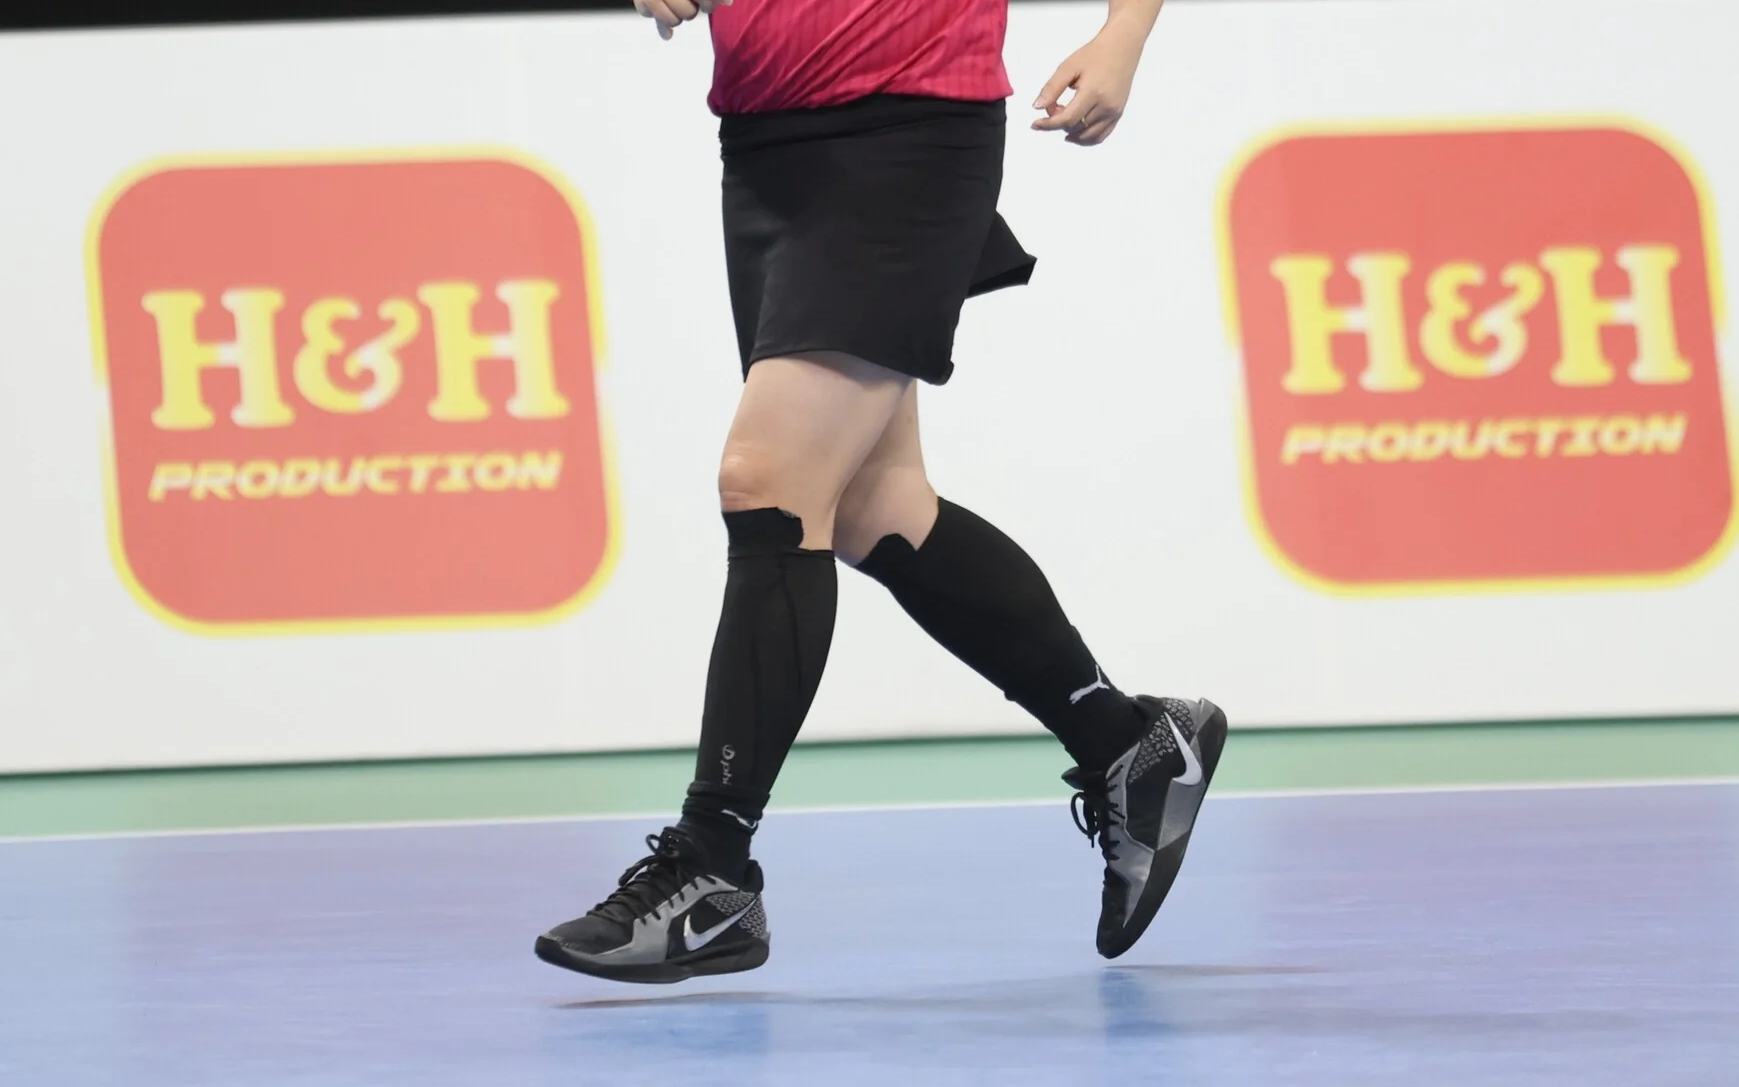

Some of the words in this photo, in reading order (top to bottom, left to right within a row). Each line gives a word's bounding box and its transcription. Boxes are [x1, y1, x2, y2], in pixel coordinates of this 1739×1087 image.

[141, 277, 570, 430] H&H
[1269, 243, 1693, 394] H&H
[147, 450, 563, 502] PRODUCTION
[1280, 413, 1688, 465] PRODUCTION
